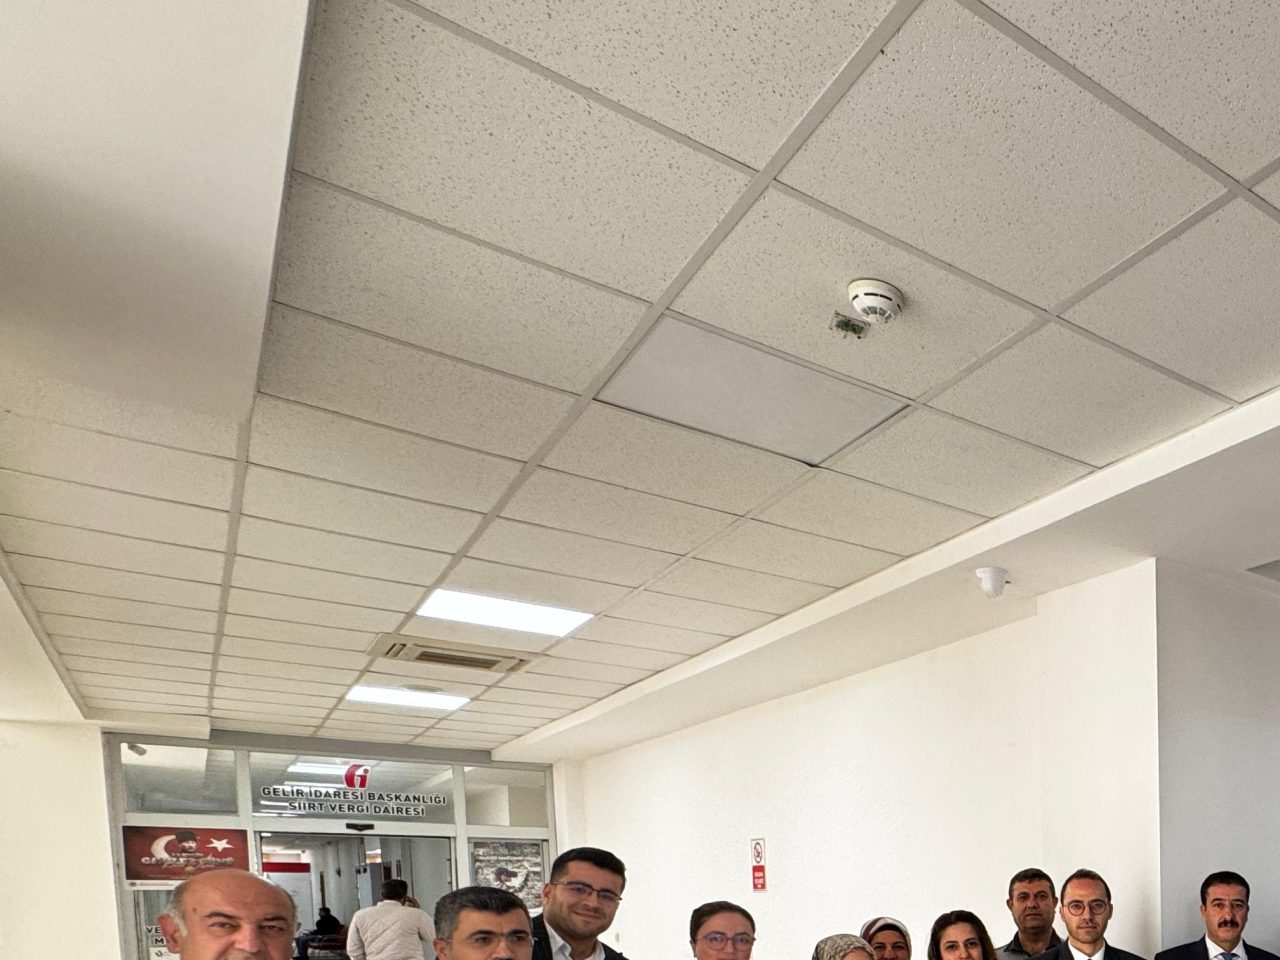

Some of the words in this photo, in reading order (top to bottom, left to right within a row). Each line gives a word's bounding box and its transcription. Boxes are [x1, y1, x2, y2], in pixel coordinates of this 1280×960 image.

[367, 791, 447, 805] BAŞKANLIĞI
[288, 800, 325, 812] SİİRT
[328, 802, 369, 814] VERGİ
[373, 804, 425, 817] DAİRESİ
